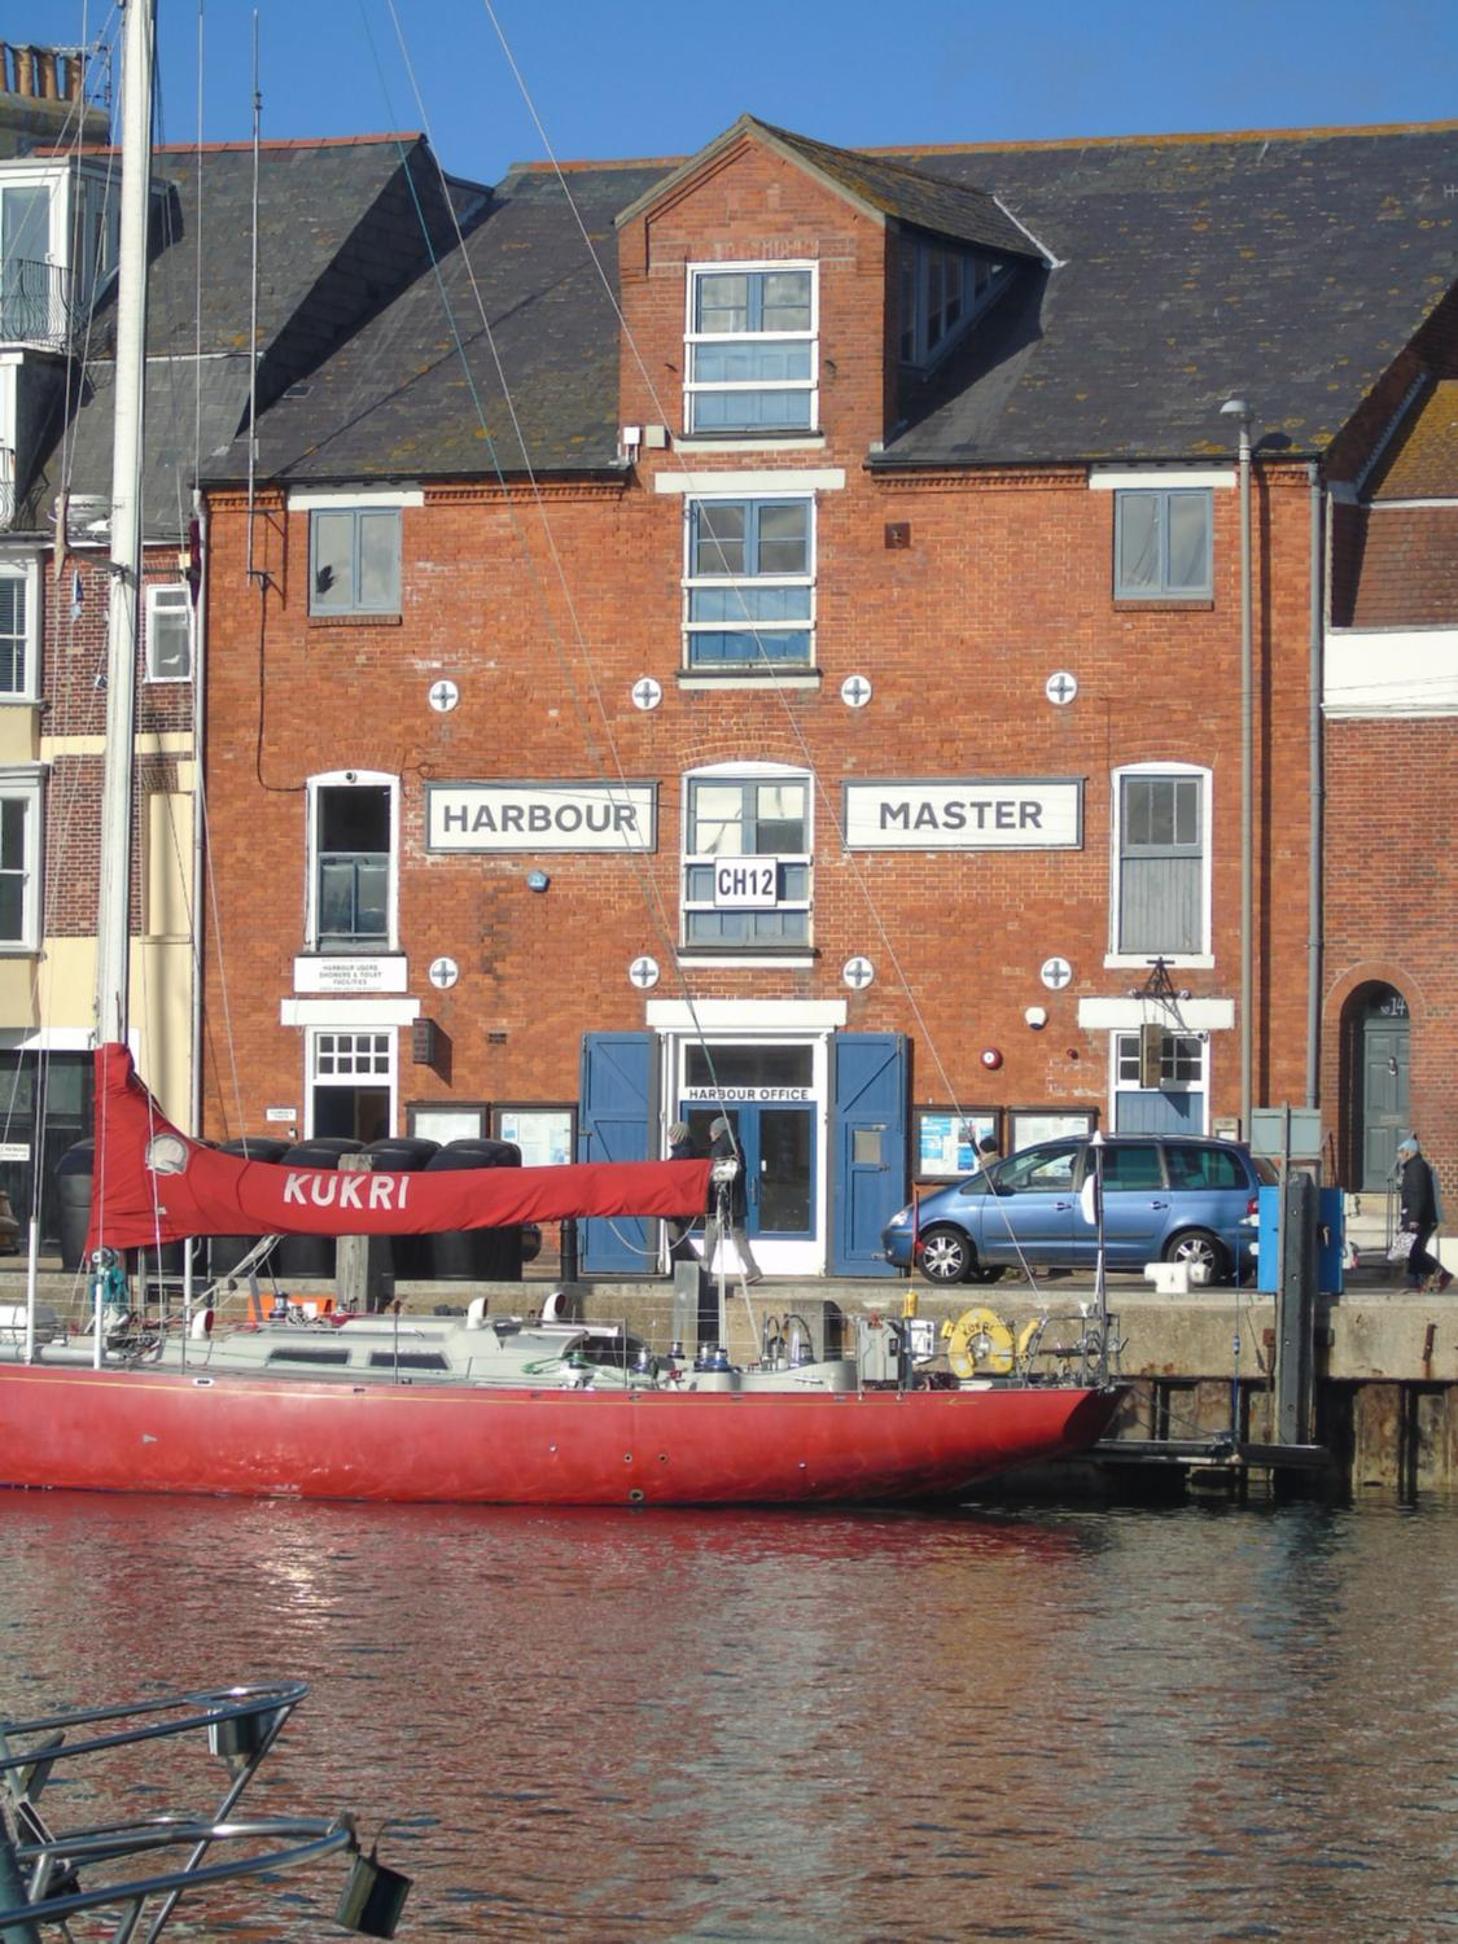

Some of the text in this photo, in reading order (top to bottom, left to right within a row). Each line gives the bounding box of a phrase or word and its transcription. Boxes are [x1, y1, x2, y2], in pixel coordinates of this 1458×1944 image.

[443, 804, 637, 832] HARBOUR
[879, 800, 1043, 830] MASTER
[718, 868, 773, 895] CH12
[1390, 997, 1406, 1016] 14
[689, 1089, 809, 1100] HARBOUR OFFICE
[283, 1172, 410, 1210] KUKRI
